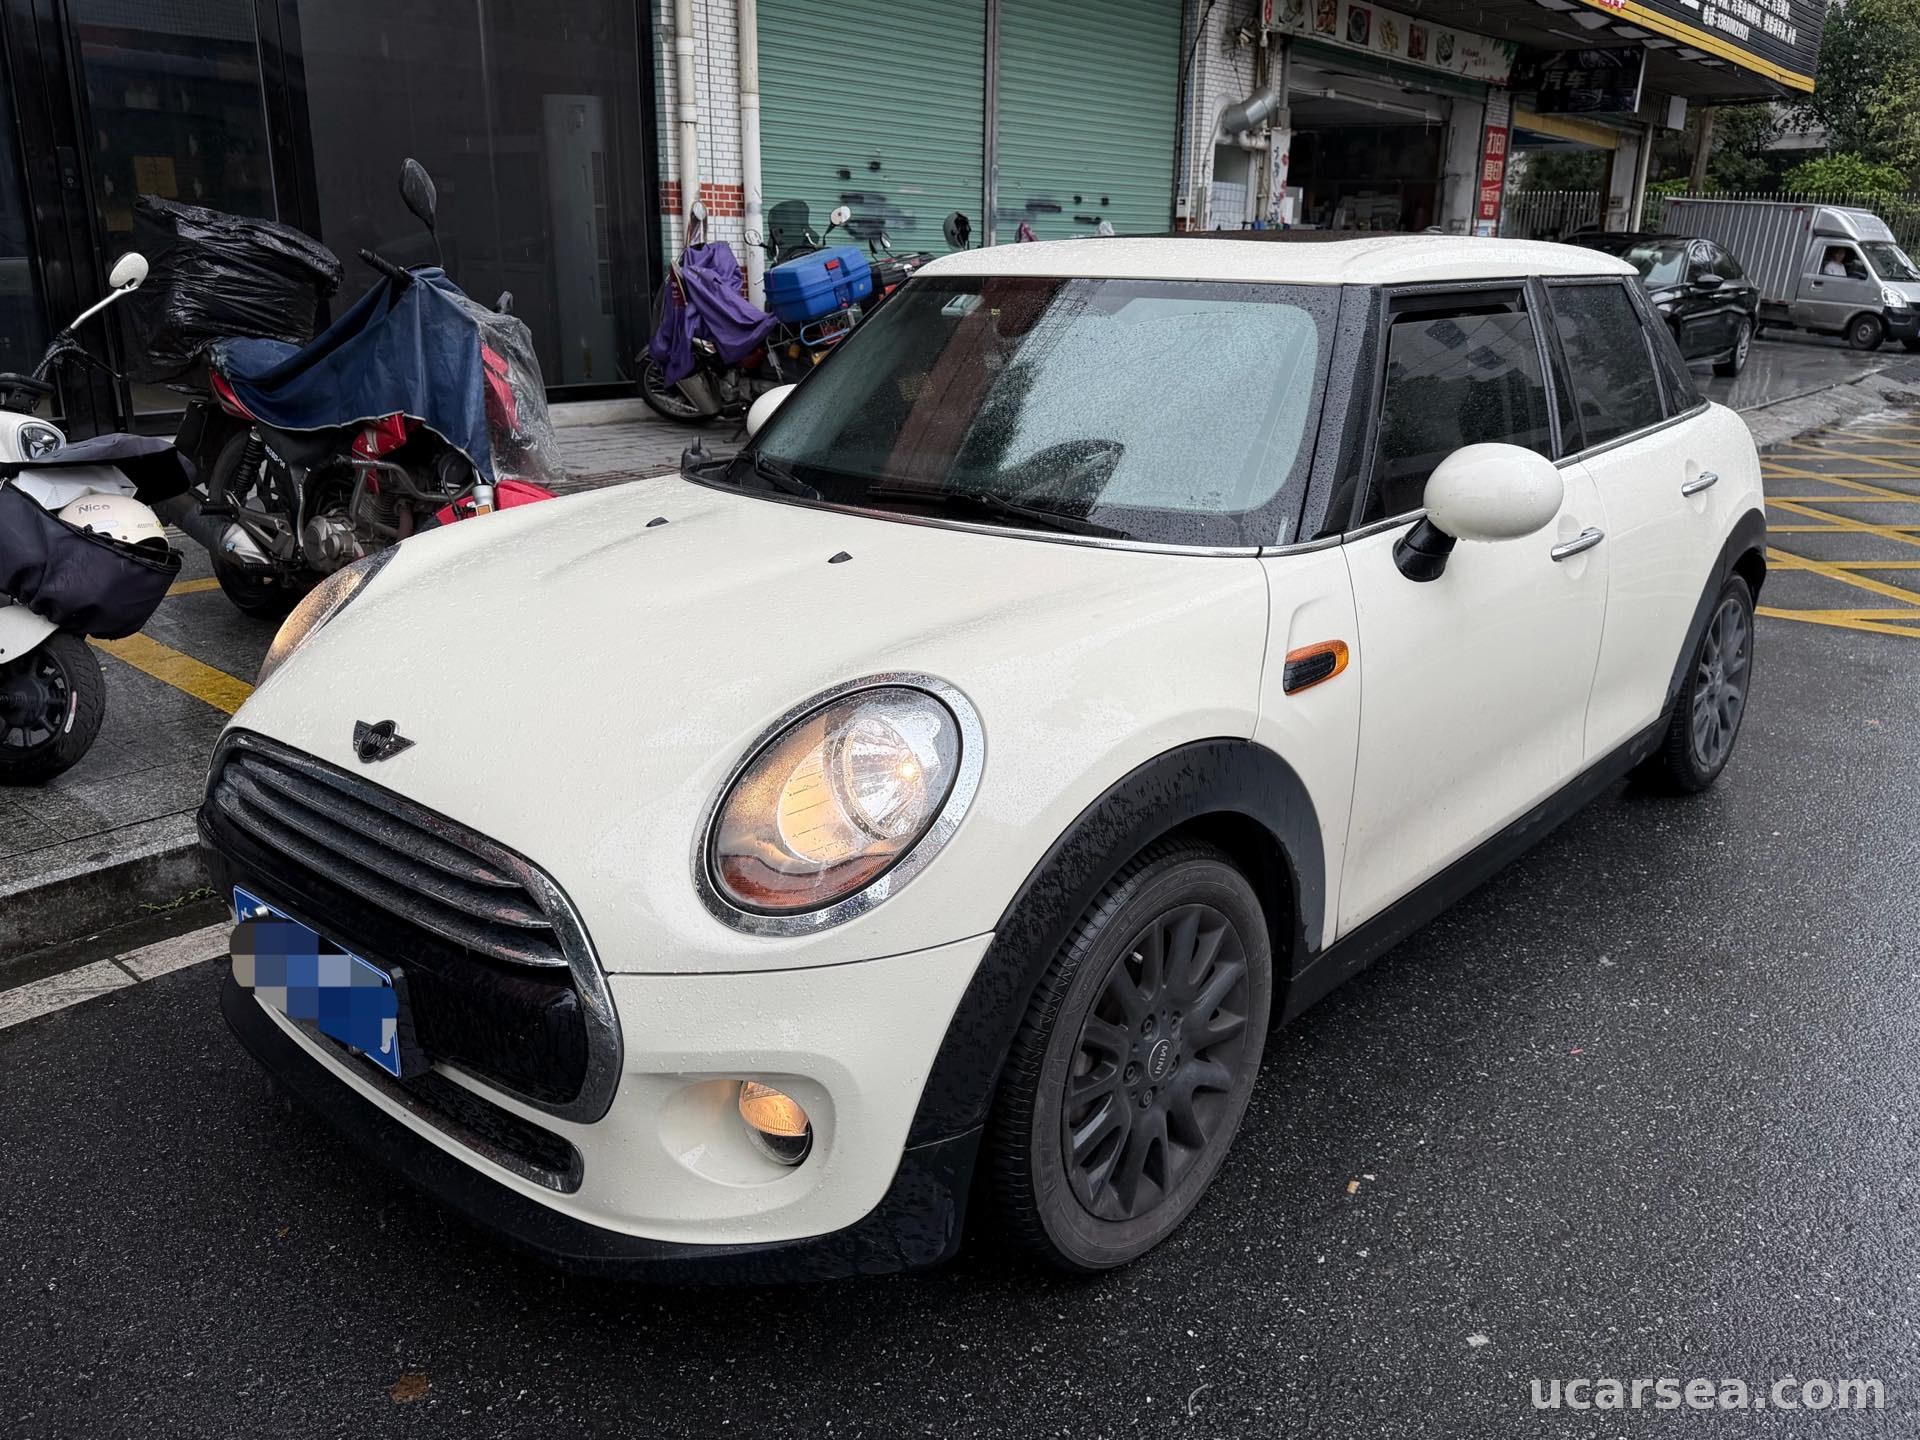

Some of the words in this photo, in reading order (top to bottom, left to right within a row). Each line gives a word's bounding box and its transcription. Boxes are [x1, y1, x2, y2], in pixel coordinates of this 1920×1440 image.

[1486, 131, 1506, 155] 打印
[78, 503, 111, 514] Nico
[1154, 1045, 1169, 1074] MINI
